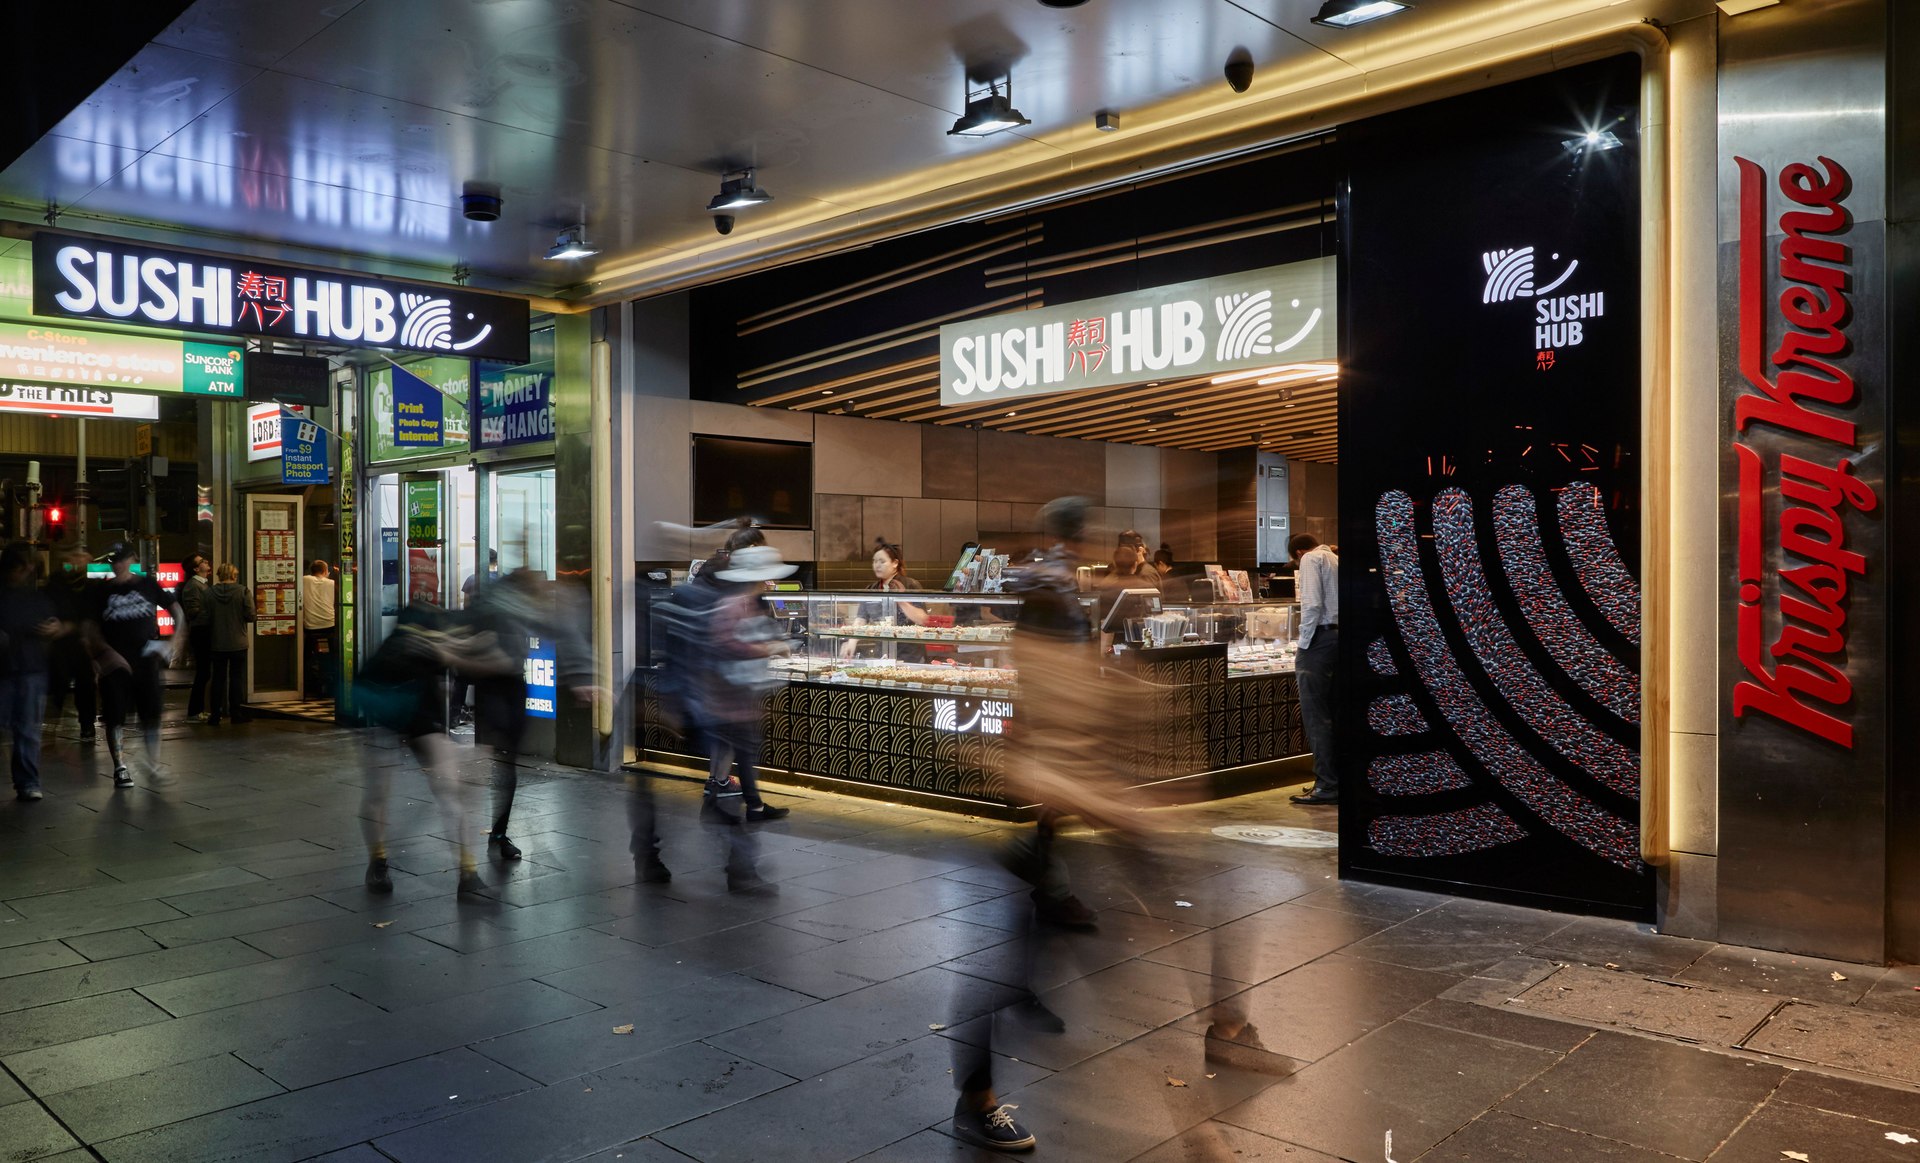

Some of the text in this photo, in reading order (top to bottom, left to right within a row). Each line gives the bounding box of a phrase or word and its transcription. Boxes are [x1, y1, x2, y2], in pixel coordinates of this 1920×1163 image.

[237, 270, 287, 301] 寿司
[54, 246, 396, 342] SUSHI HUB
[1536, 292, 1604, 323] SUSHI
[237, 301, 293, 332] ハブ
[27, 329, 88, 345] C-Store
[1067, 317, 1106, 349] 寿司
[1536, 321, 1583, 349] HUB
[952, 300, 1205, 396] SUSHI HUB
[116, 354, 175, 374] store
[1067, 345, 1111, 379] ハブ
[204, 365, 233, 376] BANK
[17, 388, 42, 400] THE
[208, 381, 234, 393] ATM
[442, 378, 468, 394] store
[493, 373, 543, 408] MONEY
[398, 402, 424, 414] Print
[252, 420, 274, 443] LORD
[398, 419, 438, 428] Photo Copy
[481, 408, 556, 444] EXCHANGE
[399, 430, 438, 442] Internet
[299, 443, 312, 454] $9
[1733, 155, 1877, 749] Krispy Kreme
[285, 454, 312, 462] Instant
[285, 462, 324, 471] Passport
[285, 469, 312, 478] Photo
[409, 524, 437, 538] $9.00
[525, 697, 554, 713] ECHSEL
[981, 700, 1013, 717] SUSHI
[981, 718, 1002, 734] HUB
